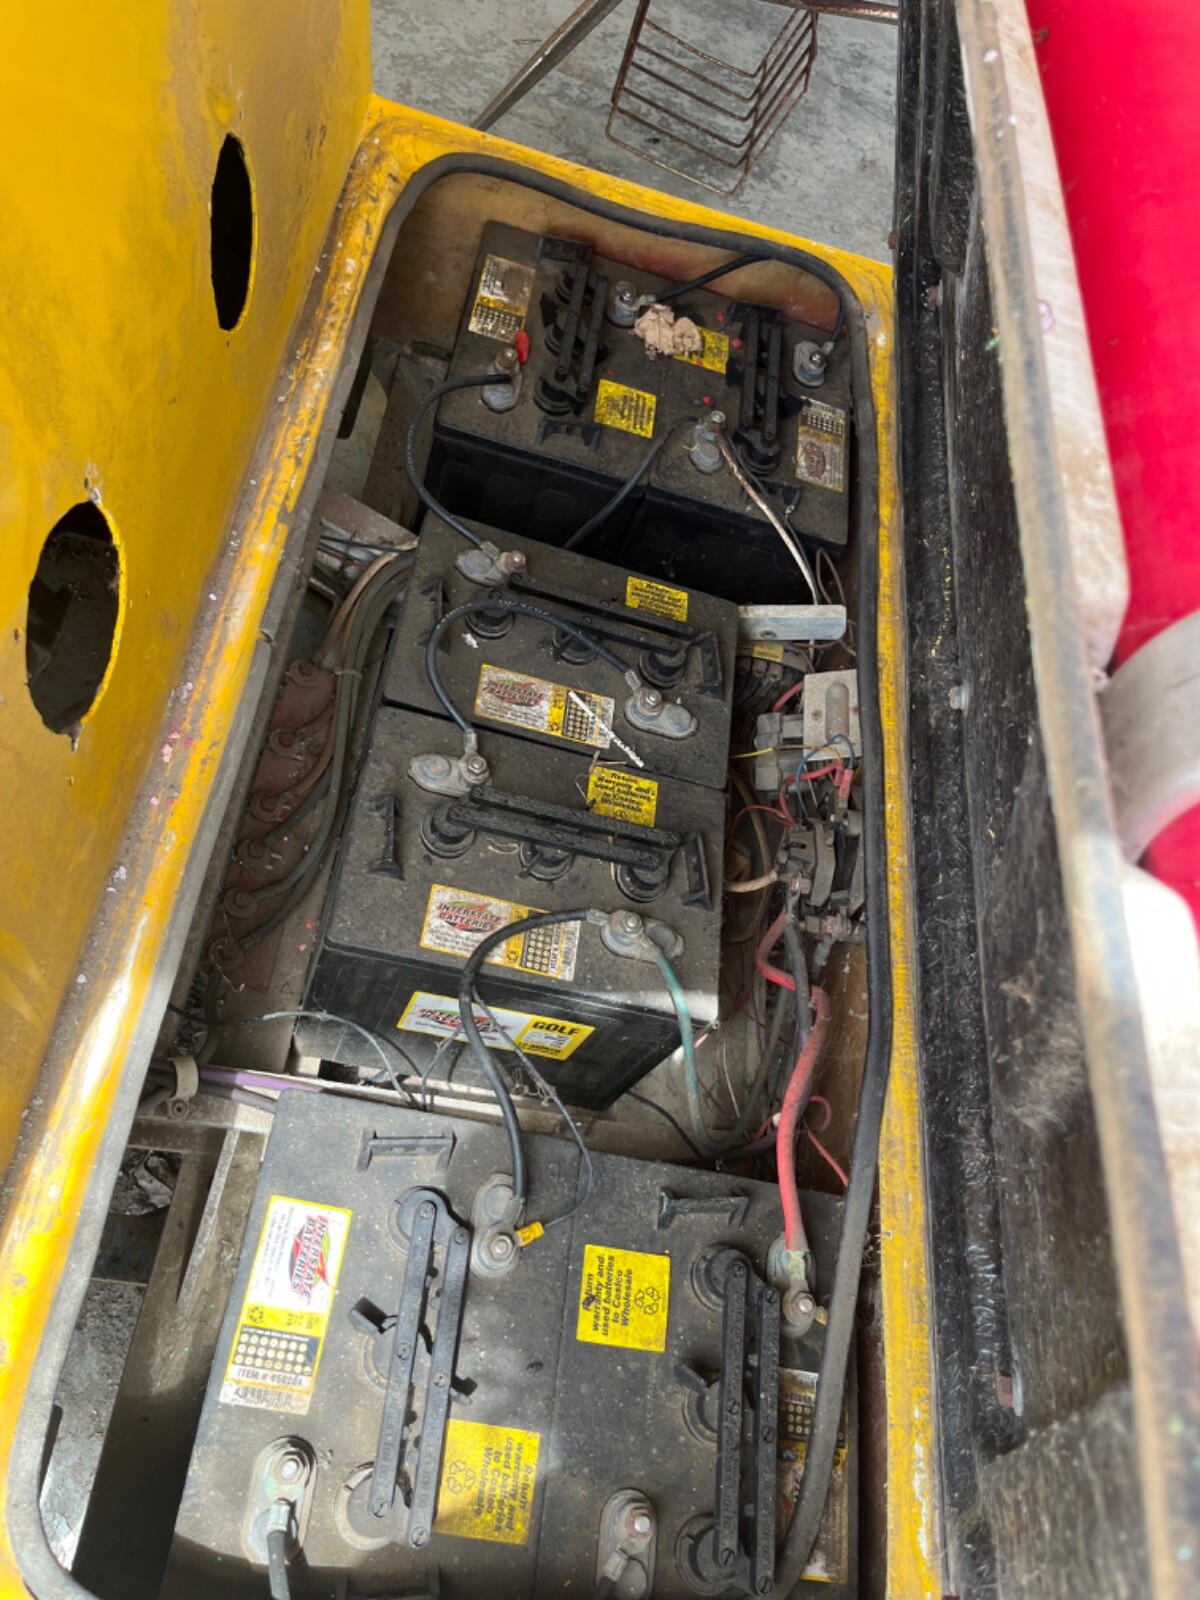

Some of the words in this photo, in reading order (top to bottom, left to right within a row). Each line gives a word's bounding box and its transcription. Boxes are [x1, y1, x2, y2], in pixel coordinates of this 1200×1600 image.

[439, 902, 502, 924] INTERSTATE
[440, 912, 495, 931] BATTERIES
[532, 1020, 579, 1036] GOLF
[293, 1217, 315, 1292] BATTERIES
[300, 1216, 329, 1300] INTERSTATE
[595, 1256, 605, 1278] and
[604, 1255, 614, 1304] batteries
[613, 1270, 623, 1308] Costco
[621, 1268, 633, 1326] Wholesale
[592, 1280, 604, 1331] warranty
[601, 1307, 610, 1336] used
[612, 1312, 619, 1323] to
[494, 1451, 502, 1463] to
[503, 1437, 515, 1469] used
[509, 1442, 524, 1500] warranty
[475, 1447, 493, 1516] Wholesale
[487, 1468, 500, 1514] Costco
[520, 1464, 532, 1509] Return
[495, 1473, 510, 1532] batteries
[506, 1504, 517, 1531] and
